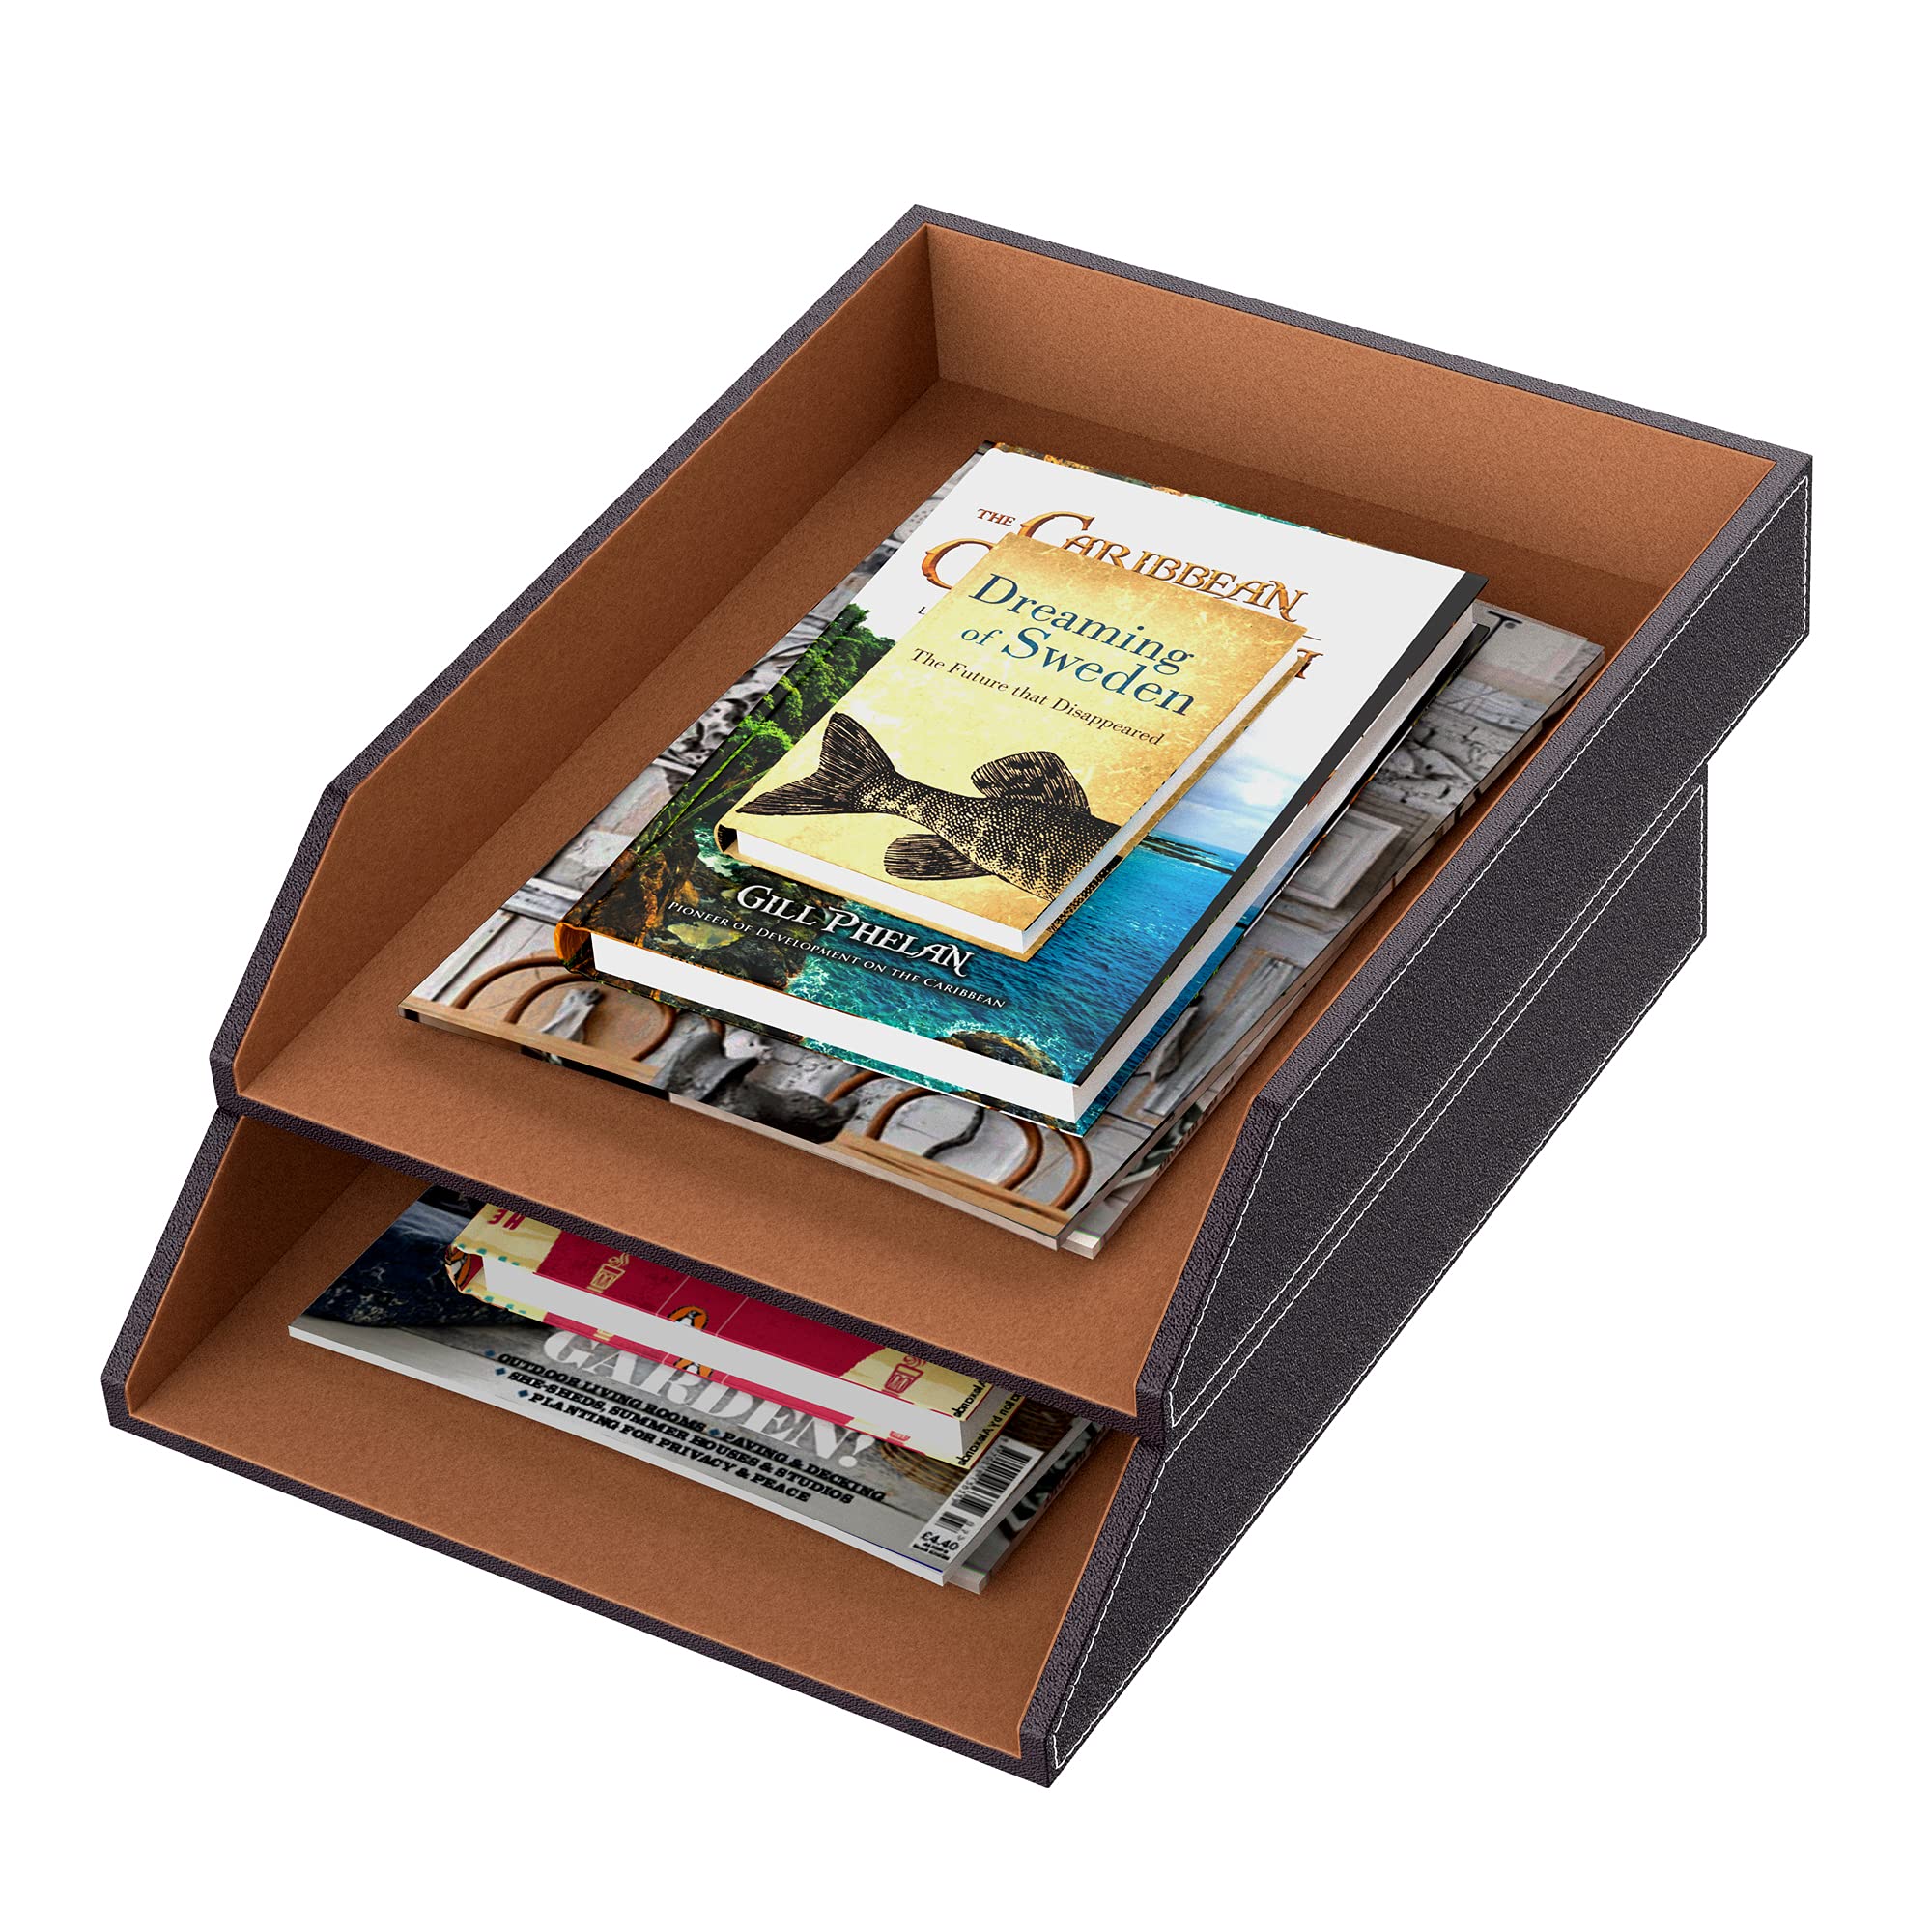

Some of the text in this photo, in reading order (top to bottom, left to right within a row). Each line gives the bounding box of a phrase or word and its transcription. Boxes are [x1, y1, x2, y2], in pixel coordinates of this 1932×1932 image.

[977, 508, 1016, 526] THE
[960, 627, 1195, 716] of Sweden
[968, 573, 1195, 675] Dreaming
[911, 648, 1165, 746] The Future that Disappeared
[668, 901, 1006, 1008] PIONEER OF DEVELOPMENT ON THE CARIBBEAN
[737, 884, 975, 977] GILL PHELAN
[497, 1353, 886, 1502] OUTDOOR LIVING ROOMS PAVING & DECKING
[508, 1371, 855, 1505] SHE-SHEDS, SUMMER HOUSES & STUDIOS
[528, 1392, 812, 1503] PLANTING FOR PRIVACY & PEACE
[544, 1330, 875, 1468] GARDEN!
[921, 1531, 959, 1551] £4.40
